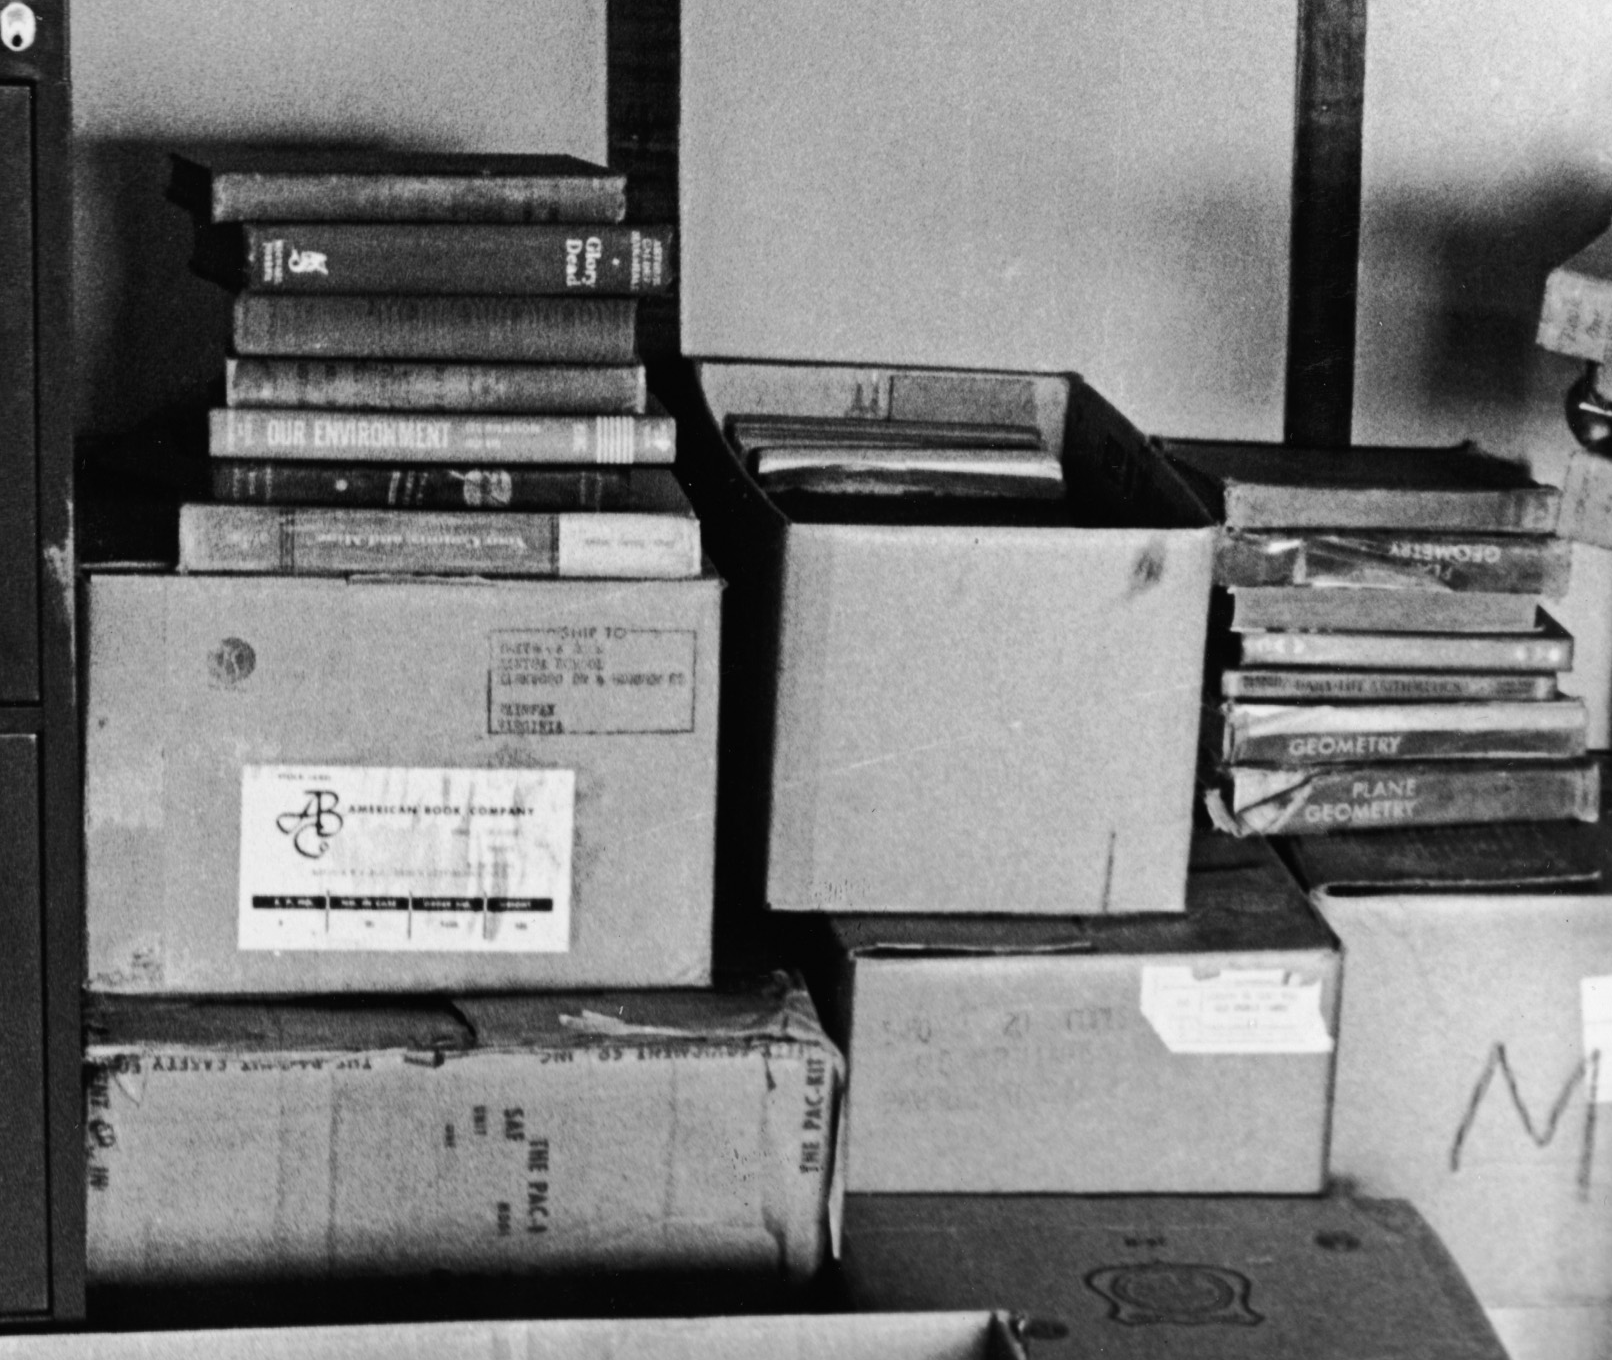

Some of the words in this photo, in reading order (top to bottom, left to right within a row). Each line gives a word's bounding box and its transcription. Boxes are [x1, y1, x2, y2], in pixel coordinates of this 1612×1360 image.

[566, 238, 583, 287] Dead
[581, 236, 602, 288] Glory
[267, 420, 305, 446] OUR
[314, 420, 452, 450] ENVIRONMENT
[1390, 541, 1501, 564] GEOMETRY
[1288, 736, 1401, 756] GEOMETRY
[1352, 779, 1417, 798] PLANE
[348, 806, 418, 816] AMERICAN
[424, 806, 462, 816] BOOK
[469, 807, 535, 817] COMPANY
[1304, 800, 1417, 823] GEOMETRY
[802, 1057, 826, 1130] PAC-KIT
[528, 1138, 550, 1172] THE
[799, 1141, 823, 1173] THE
